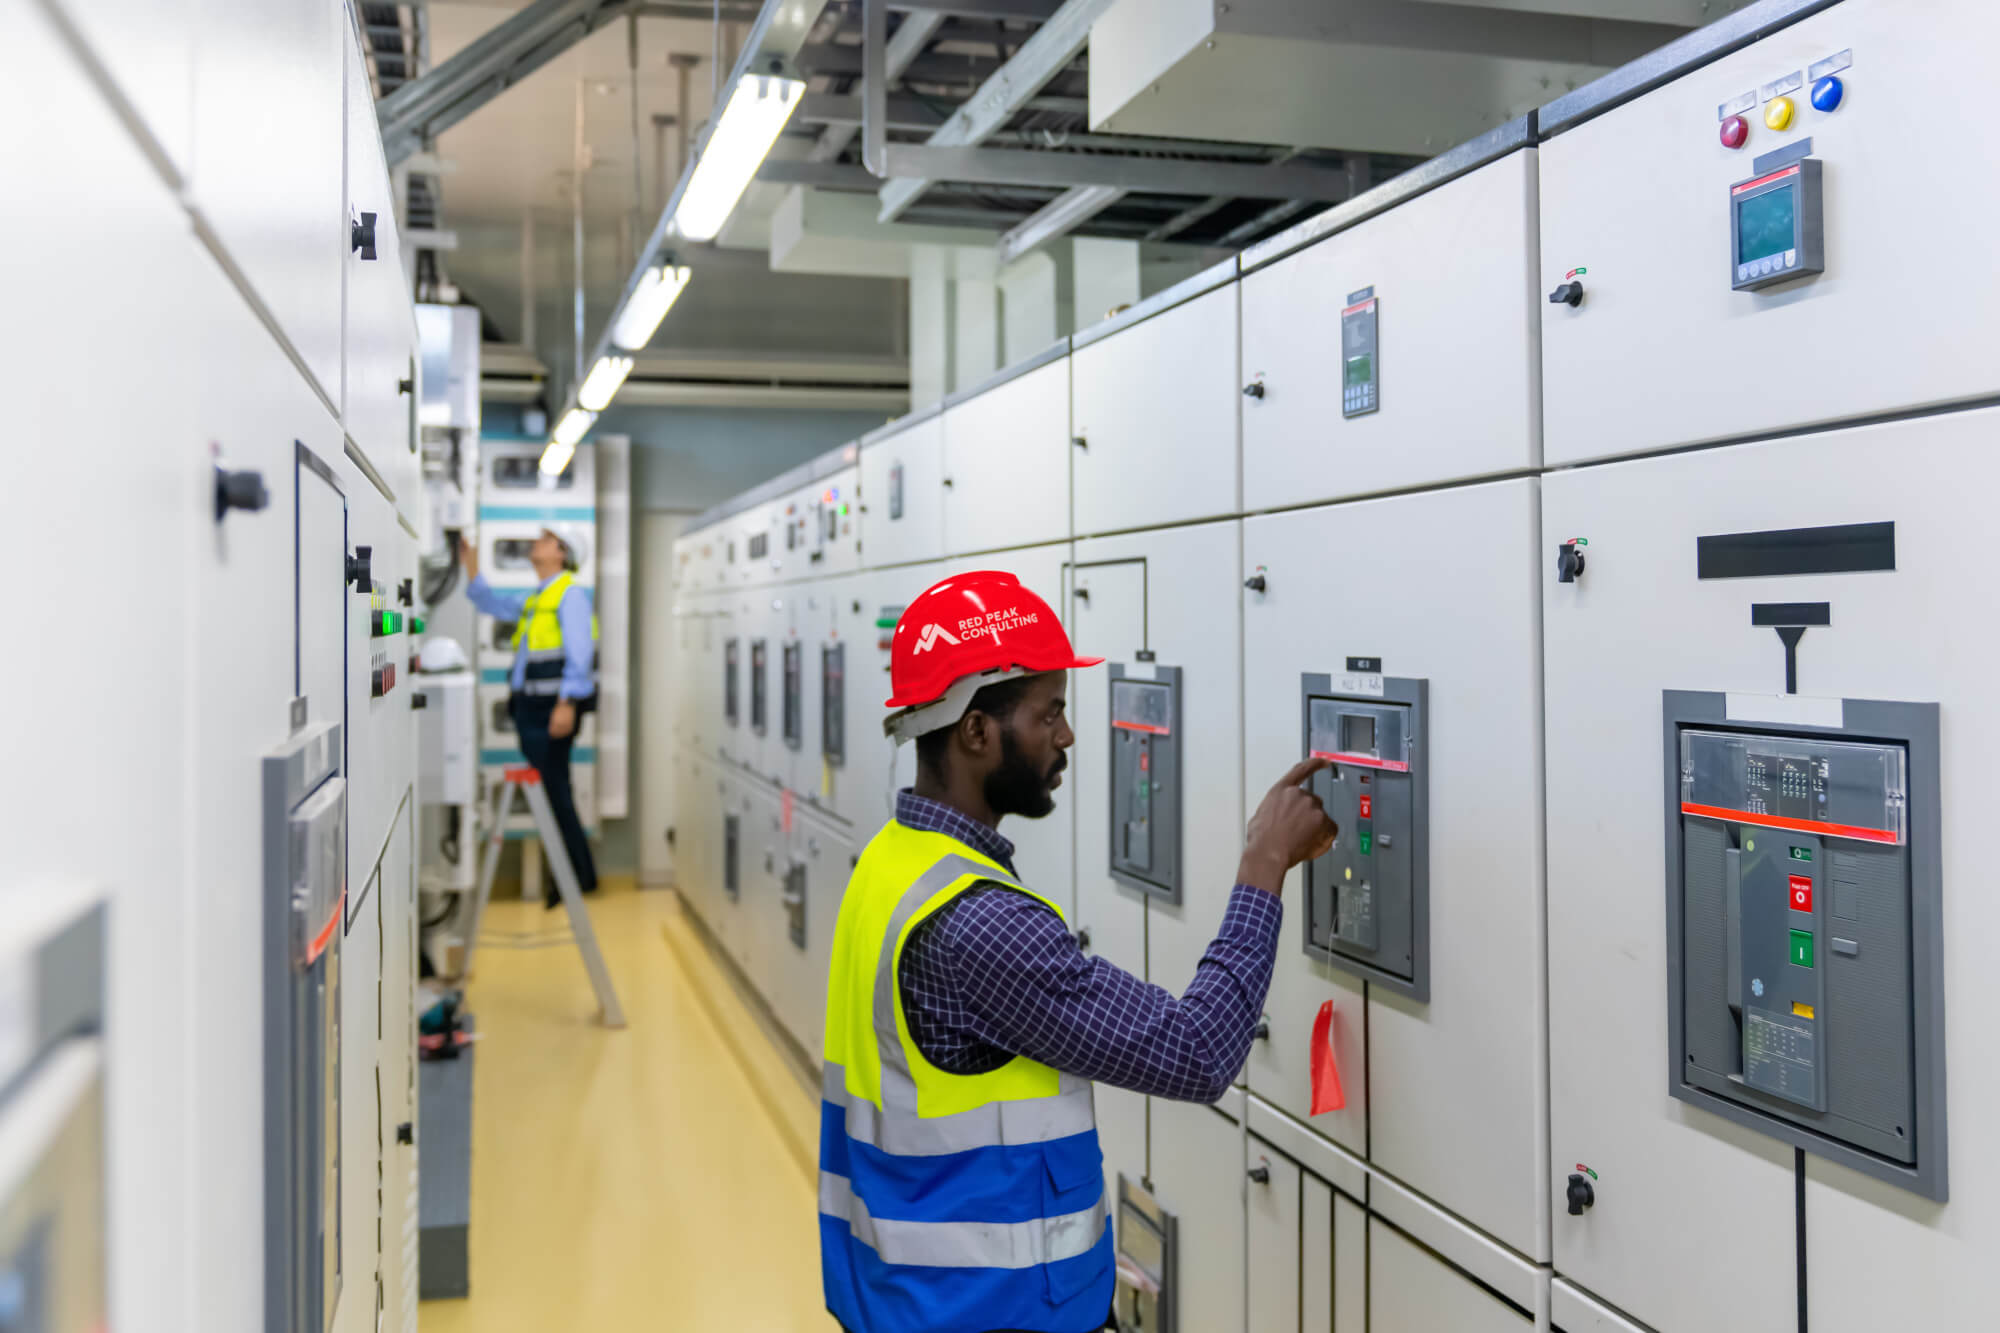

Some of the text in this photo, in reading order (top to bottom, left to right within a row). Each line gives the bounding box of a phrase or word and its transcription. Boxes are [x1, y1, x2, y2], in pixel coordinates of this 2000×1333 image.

[958, 607, 1019, 630] RED PEAK
[961, 613, 1038, 640] CONSULTING
